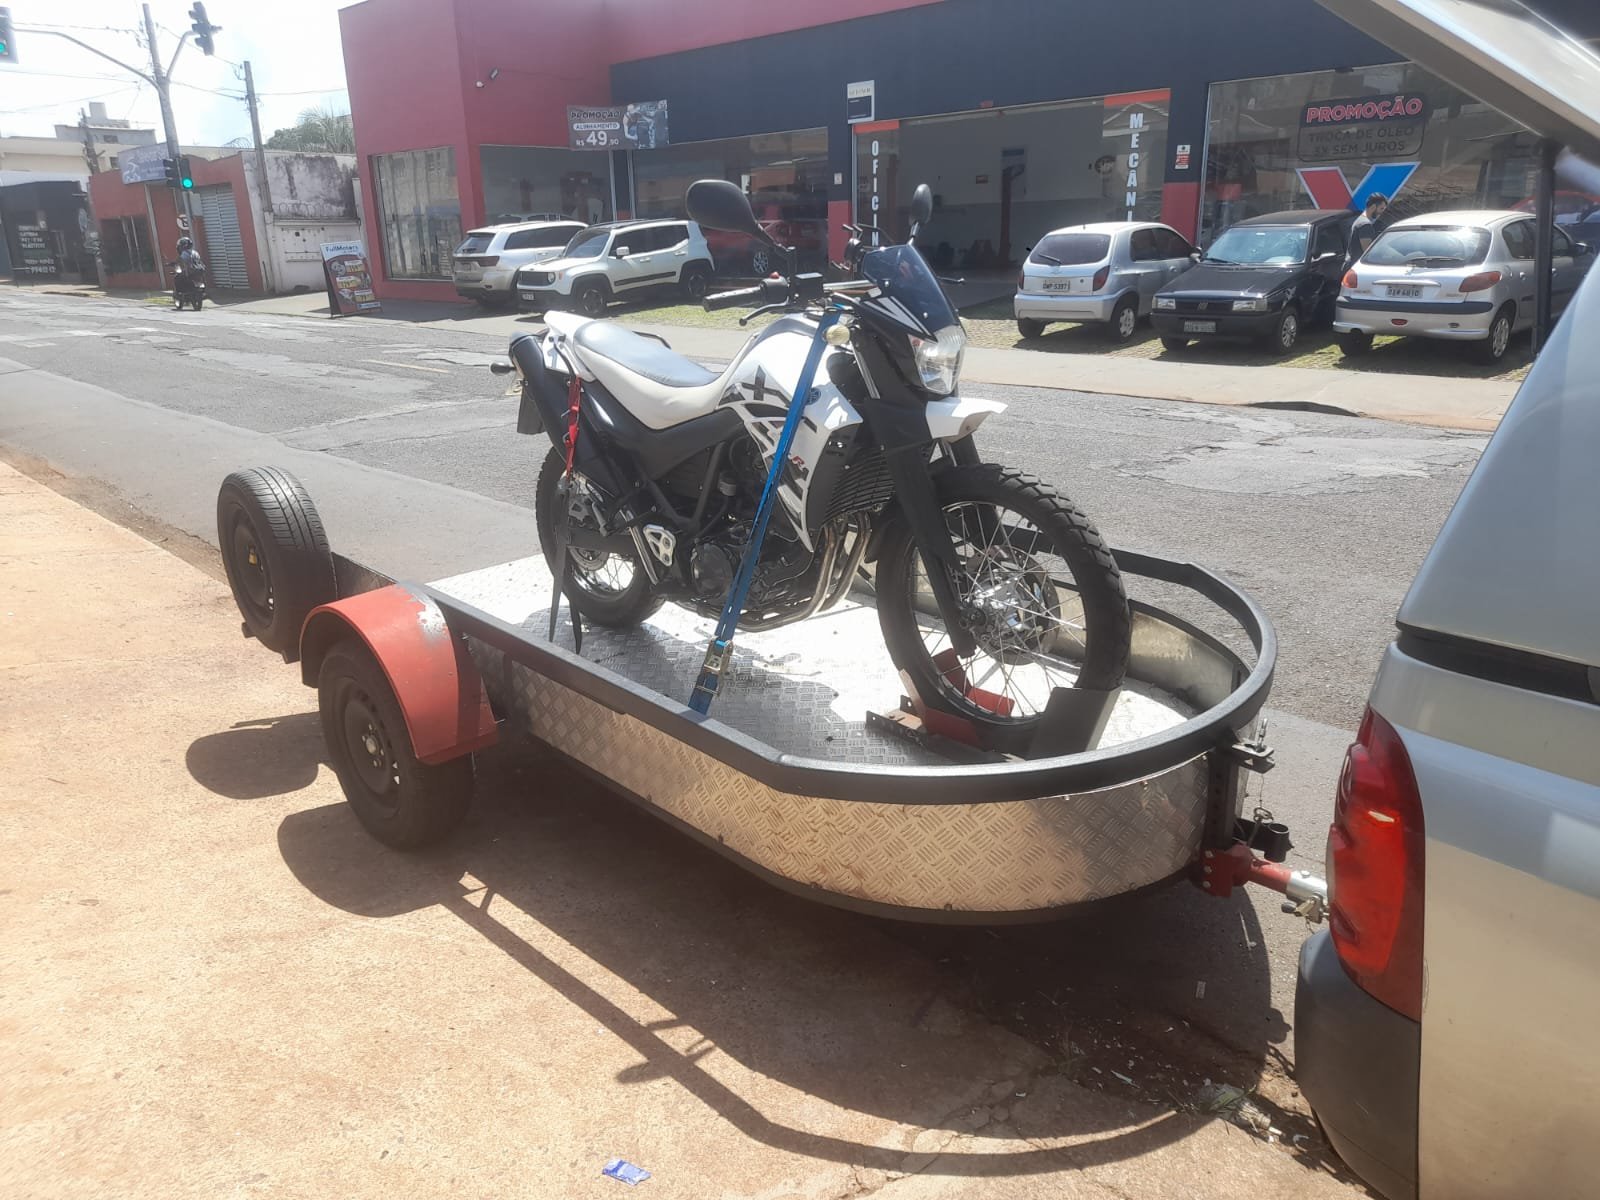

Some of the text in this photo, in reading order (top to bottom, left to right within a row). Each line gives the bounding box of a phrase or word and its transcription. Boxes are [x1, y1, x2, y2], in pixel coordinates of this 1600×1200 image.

[1306, 96, 1423, 123] PROMOÇÃO
[1356, 128, 1374, 139] DE
[1333, 143, 1358, 154] SEM
[1362, 140, 1406, 152] JUROS
